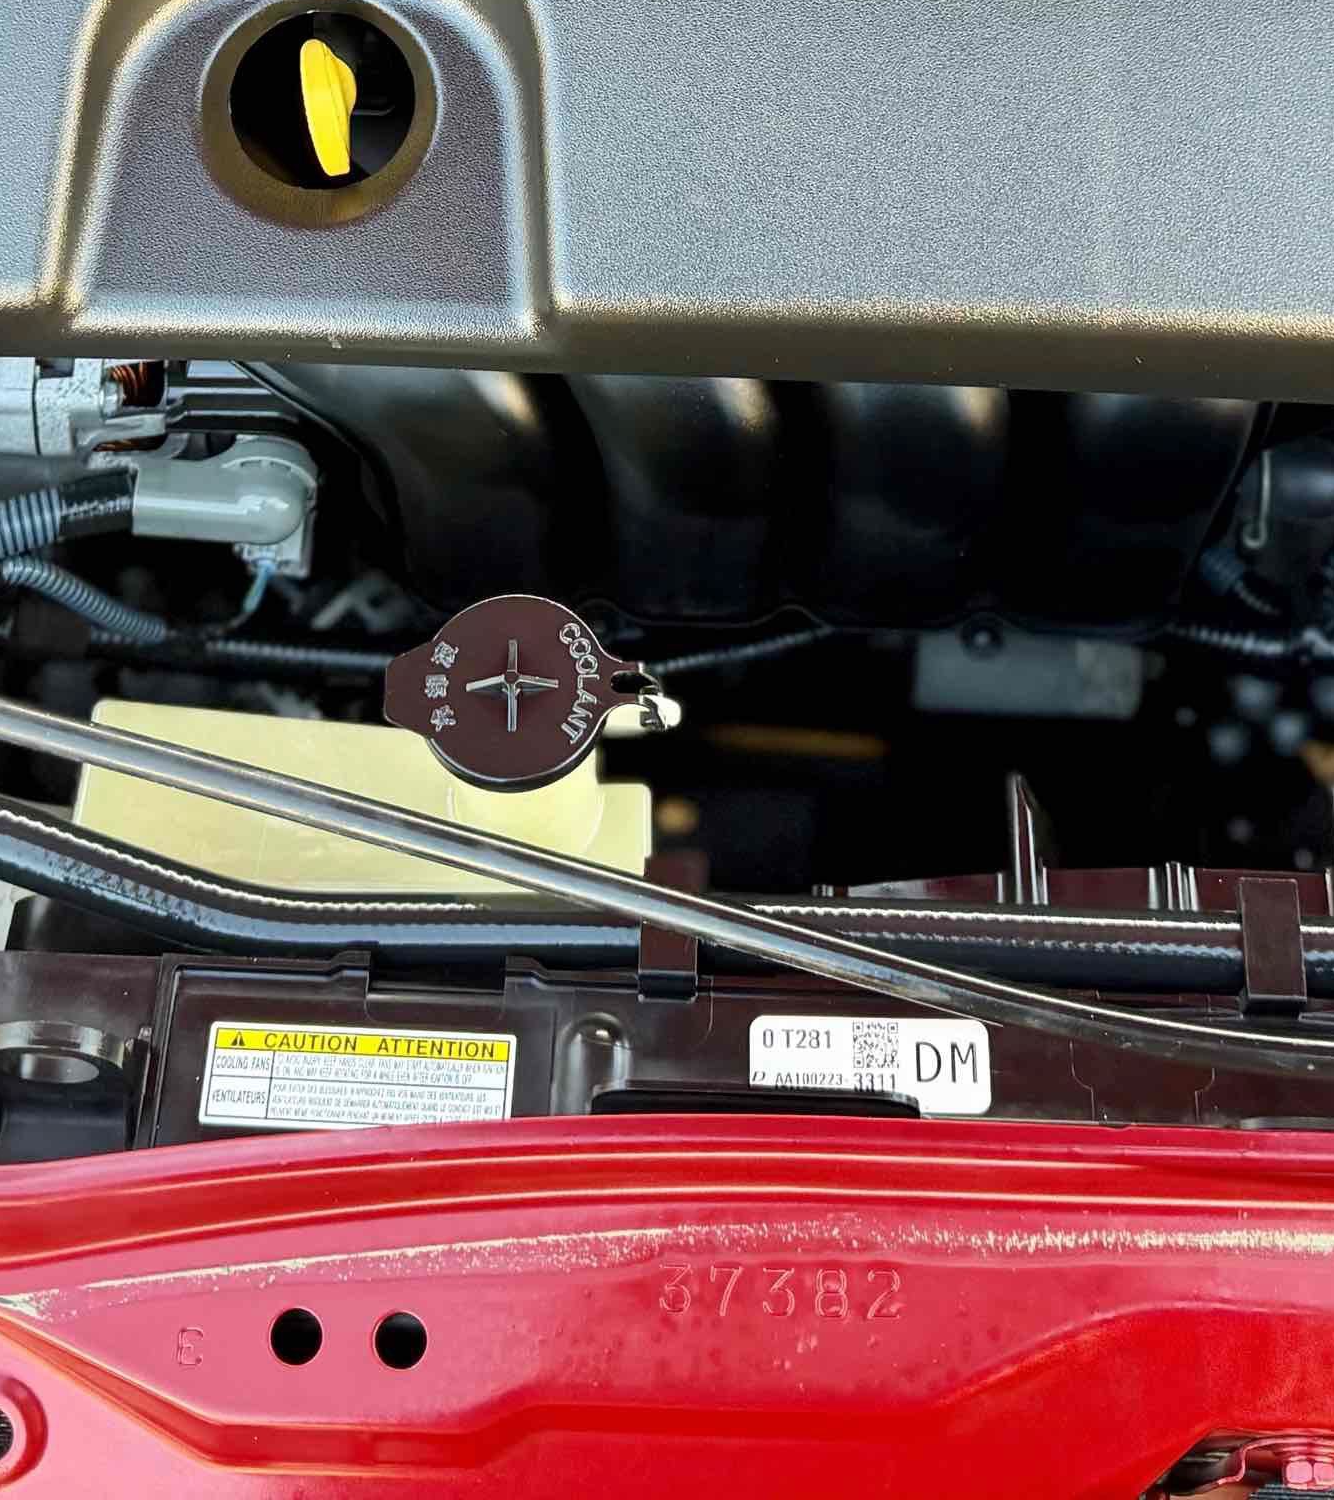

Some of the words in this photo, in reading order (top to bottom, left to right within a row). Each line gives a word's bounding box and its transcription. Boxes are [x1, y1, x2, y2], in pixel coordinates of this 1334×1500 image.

[559, 622, 600, 744] COOLANT
[264, 1032, 357, 1052] CAUTION
[377, 1037, 495, 1059] ATTENTION
[782, 1029, 831, 1049] T281
[215, 1055, 249, 1069] COOLING
[251, 1056, 270, 1071] FANS
[915, 1041, 978, 1083] DM
[212, 1089, 267, 1105] VENTILATEURS
[658, 1263, 902, 1320] 37382
